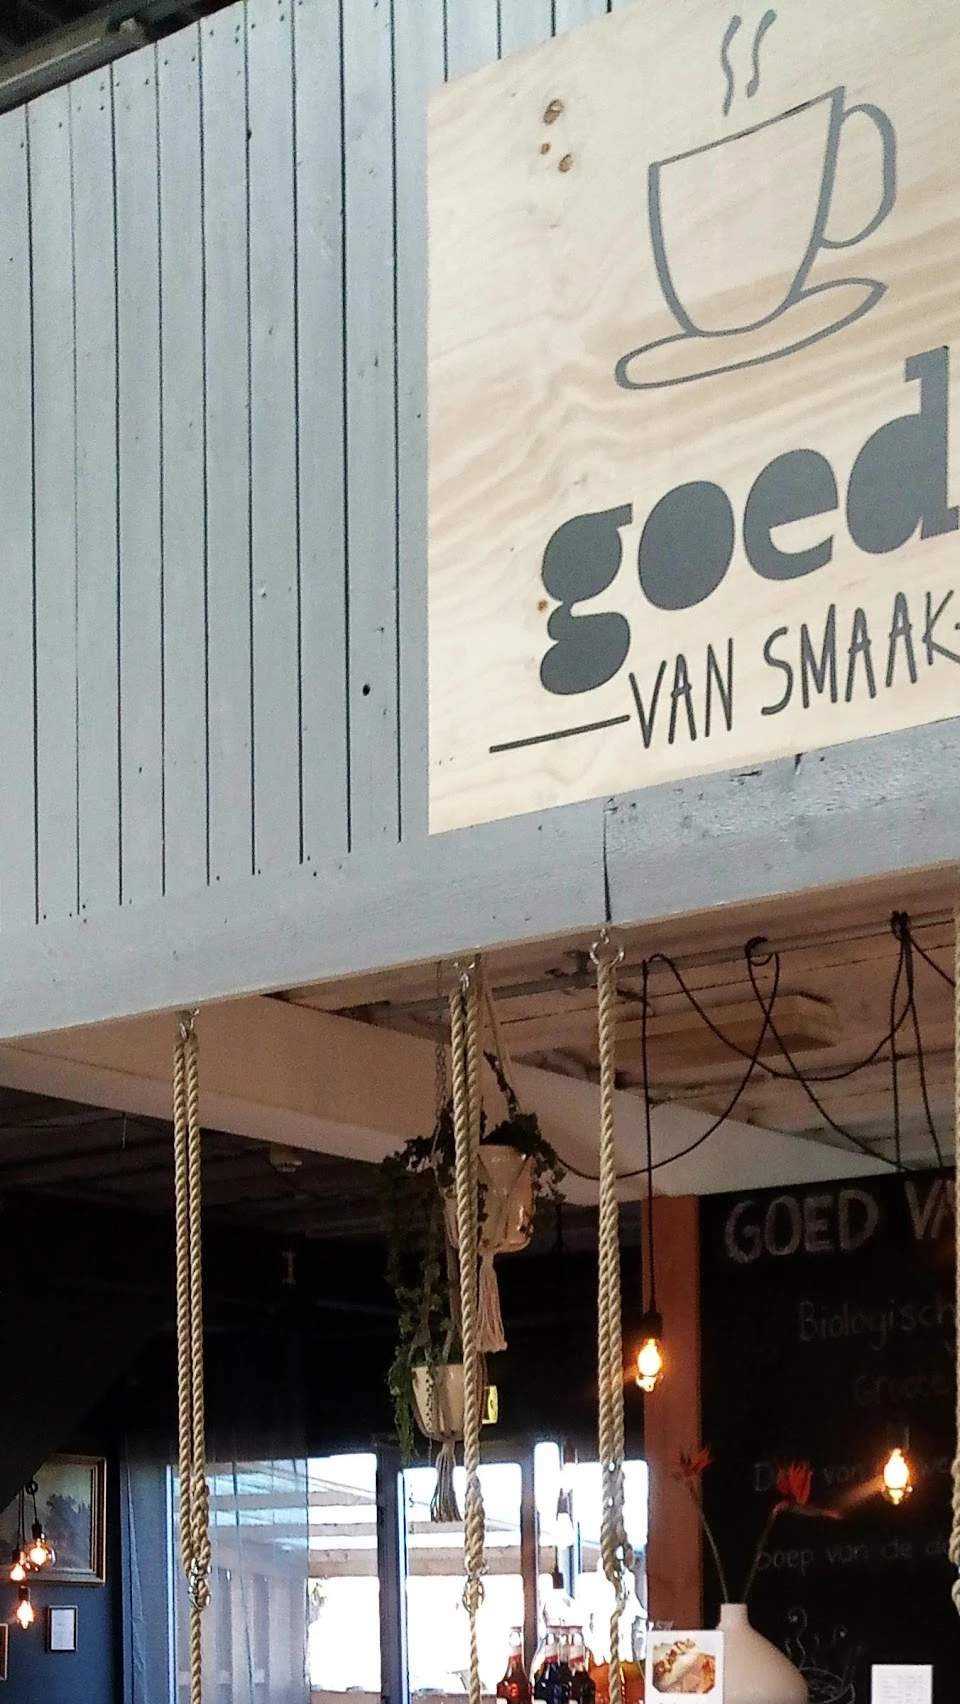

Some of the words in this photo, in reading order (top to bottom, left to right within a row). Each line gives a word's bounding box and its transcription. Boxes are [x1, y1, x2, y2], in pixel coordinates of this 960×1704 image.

[540, 345, 960, 696] goed
[629, 638, 734, 749] VAN
[722, 1186, 880, 1264] GOED
